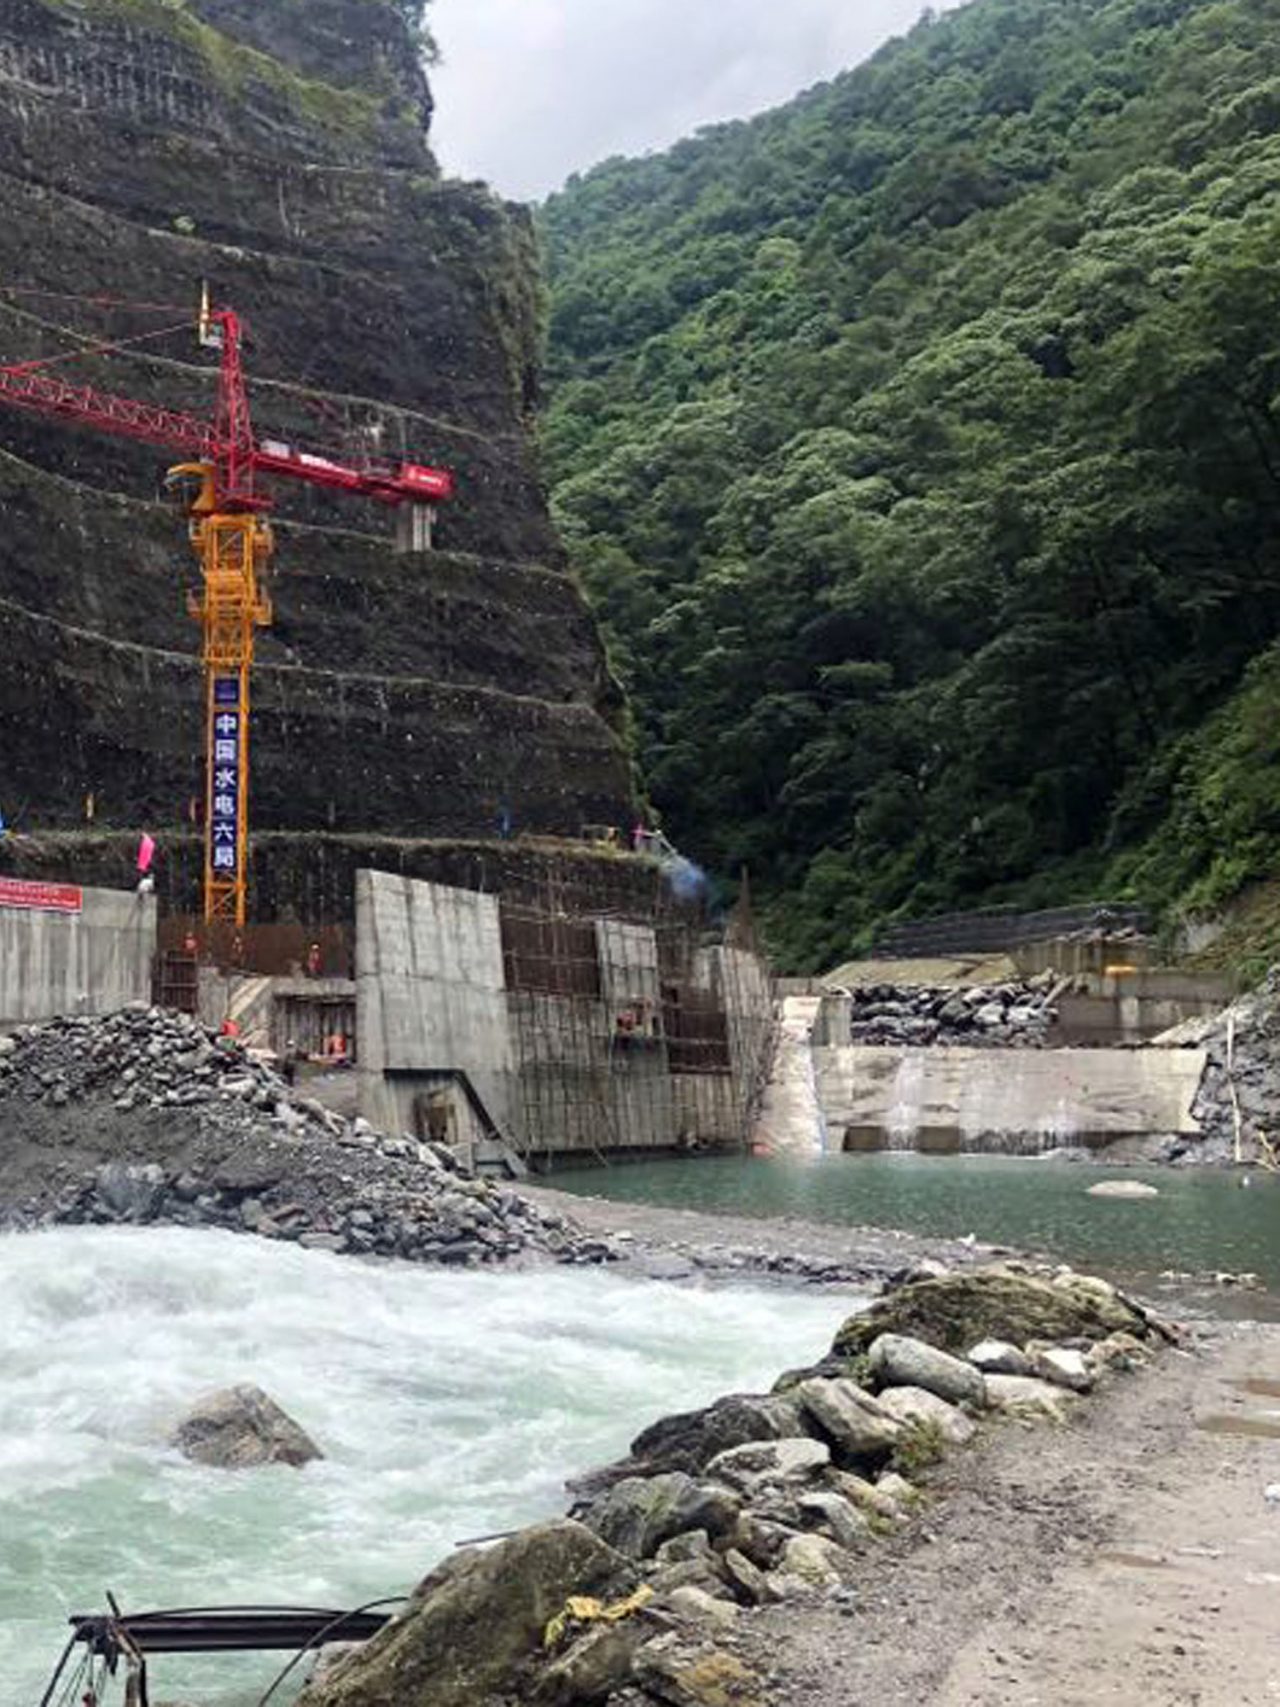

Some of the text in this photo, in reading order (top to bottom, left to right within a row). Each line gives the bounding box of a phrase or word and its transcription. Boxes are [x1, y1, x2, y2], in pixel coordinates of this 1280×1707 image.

[214, 713, 237, 868] 中国水电六局
